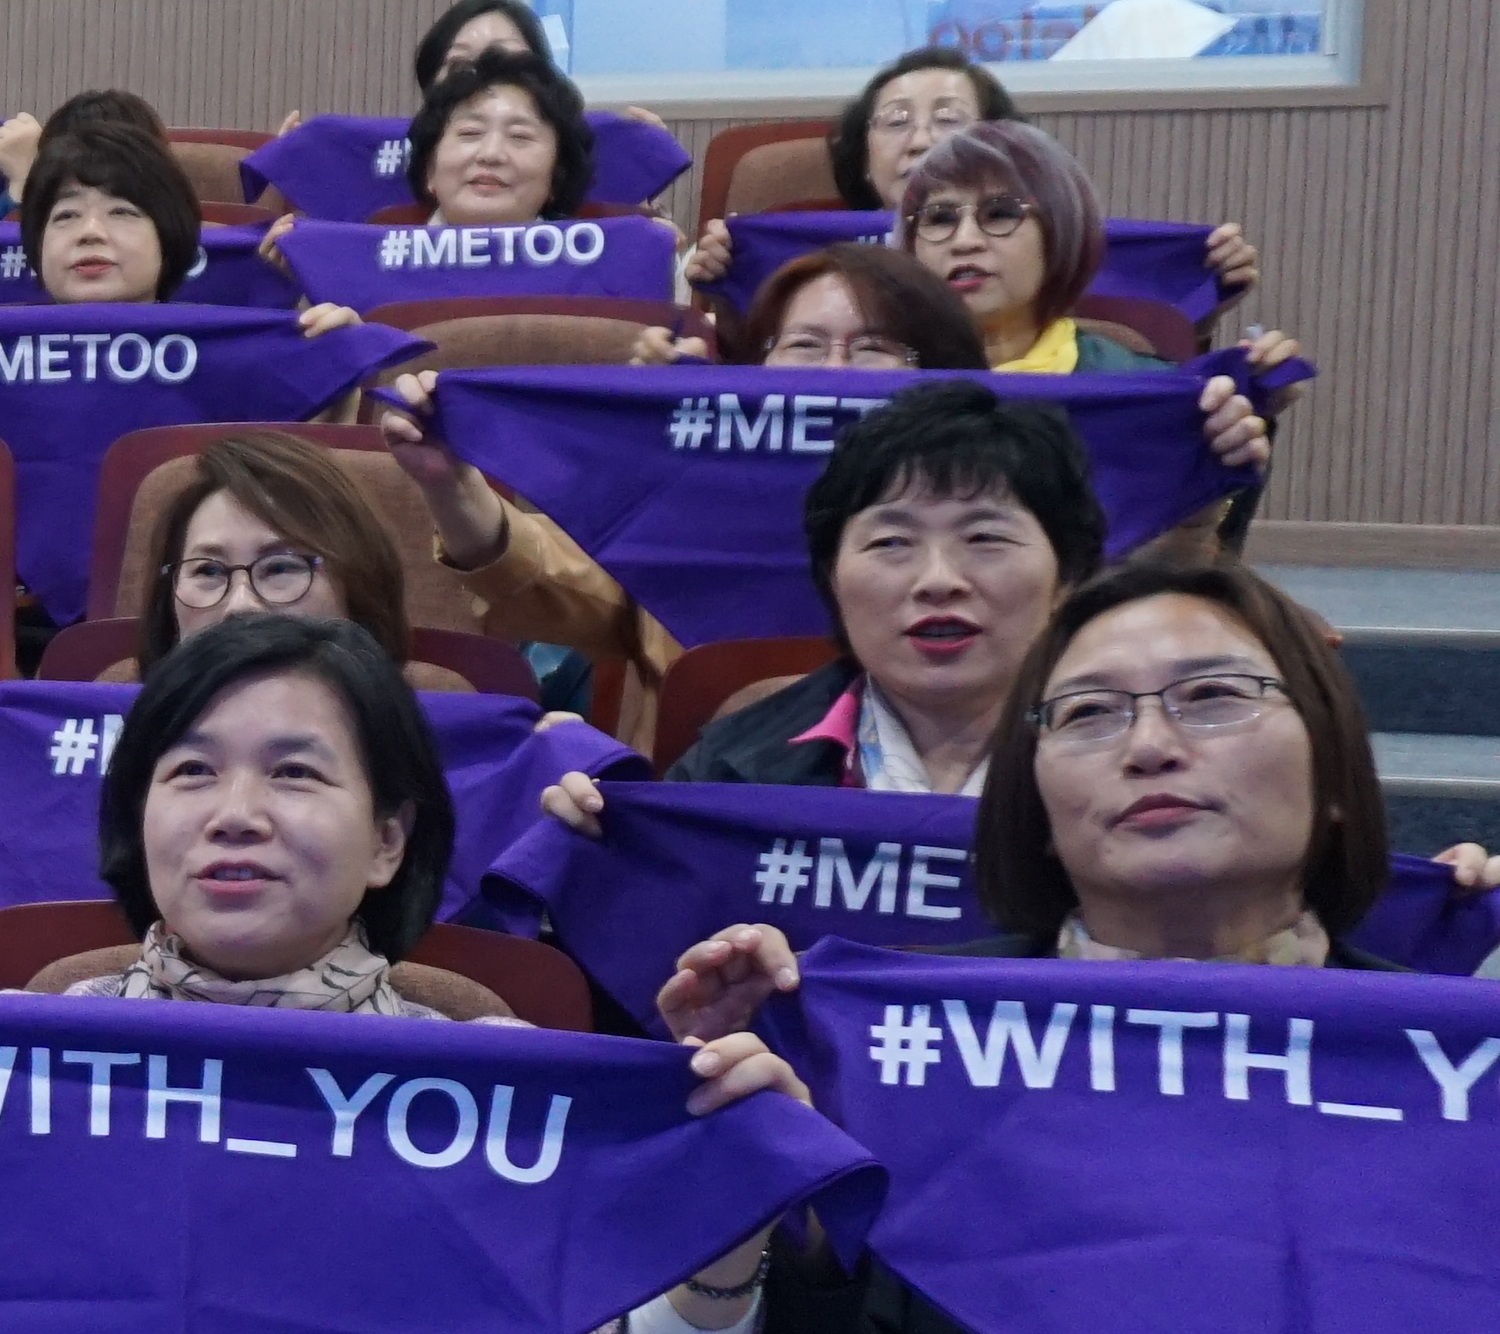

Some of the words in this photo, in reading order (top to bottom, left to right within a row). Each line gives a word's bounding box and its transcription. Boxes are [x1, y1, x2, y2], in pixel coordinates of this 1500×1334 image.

[381, 223, 604, 265] #METOO
[756, 838, 966, 919] #ME
[870, 1000, 1500, 1121] #WITH_Y
